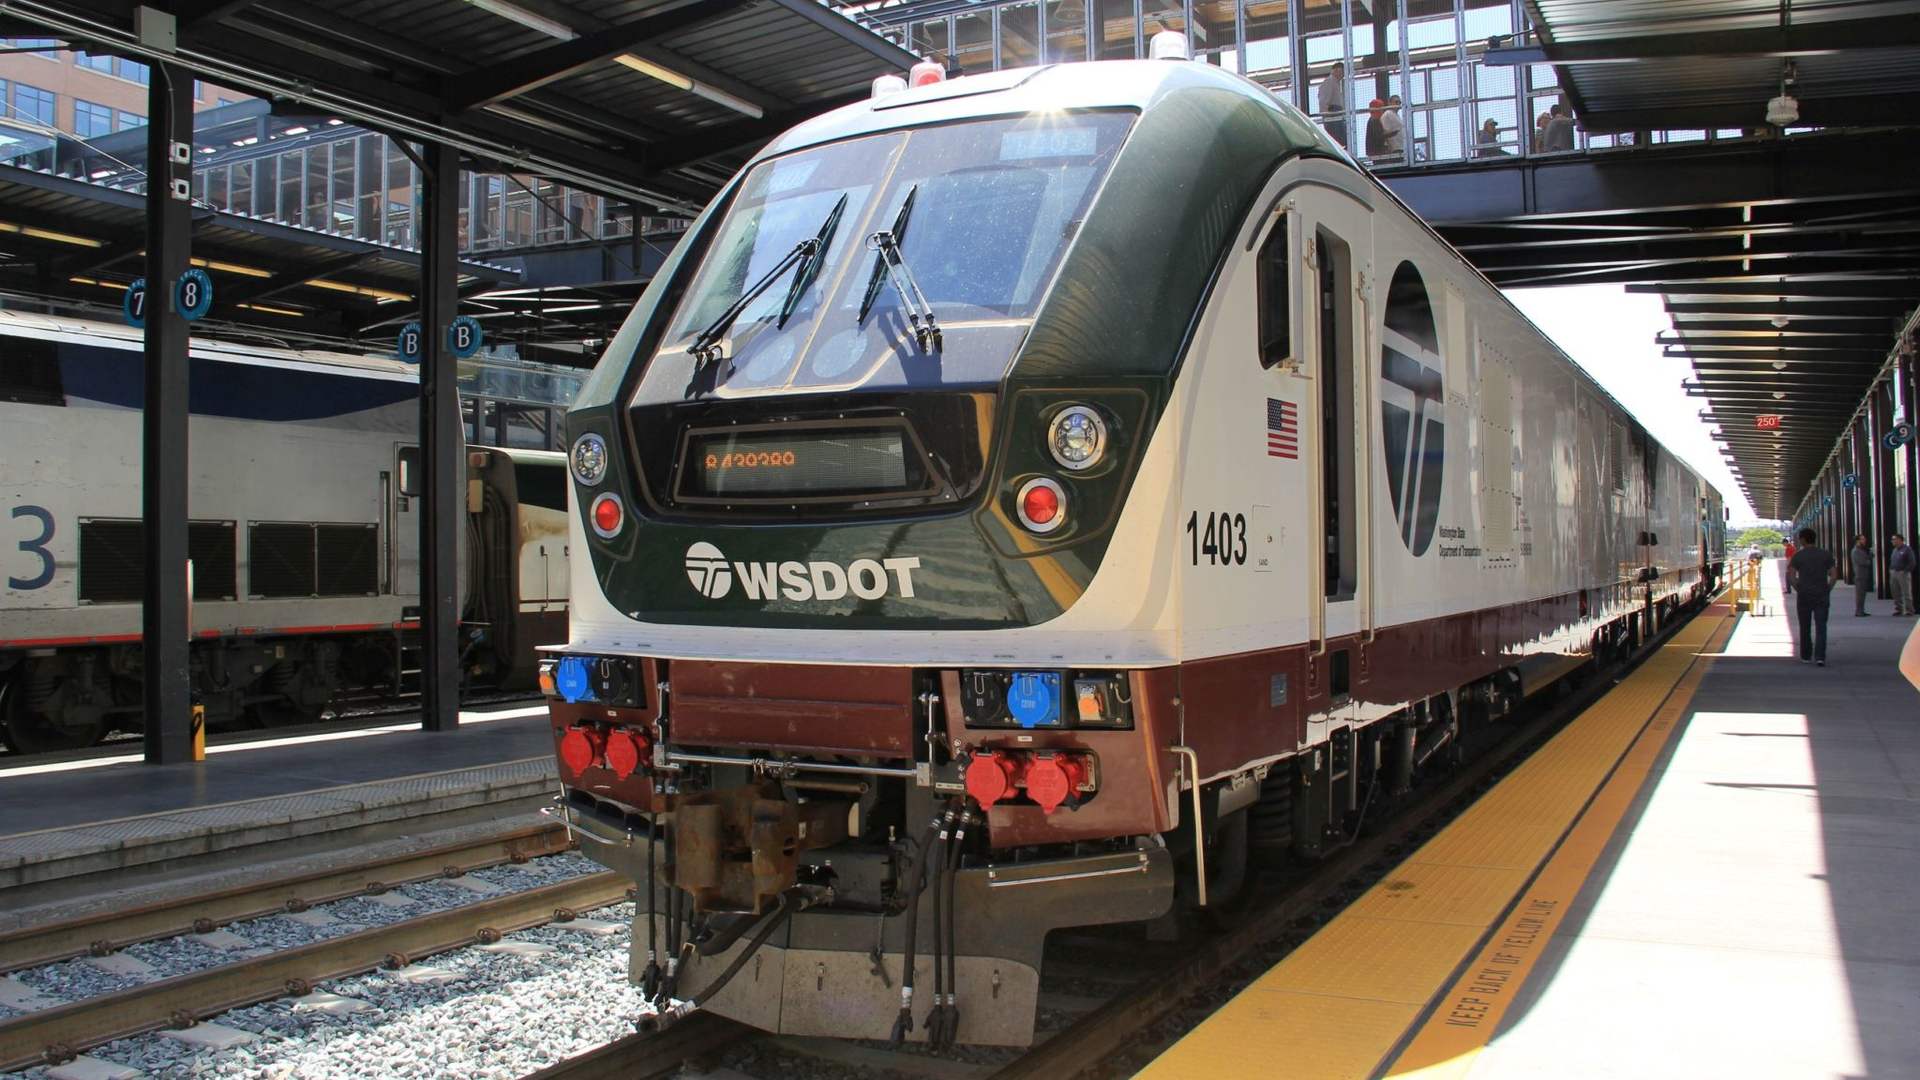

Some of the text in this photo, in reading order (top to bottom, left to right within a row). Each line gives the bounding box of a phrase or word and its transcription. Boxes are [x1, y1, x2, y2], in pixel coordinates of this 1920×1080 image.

[129, 279, 146, 293] TRAC
[185, 282, 197, 308] 8
[134, 291, 145, 316] 7
[406, 333, 418, 354] B
[457, 326, 470, 348] B
[1899, 427, 1908, 438] 9
[8, 504, 57, 591] 3
[1187, 510, 1248, 566] 1403
[733, 556, 921, 602] WSDOT
[1445, 899, 1559, 1028] KEEP BACK OF YELLOW LINE
